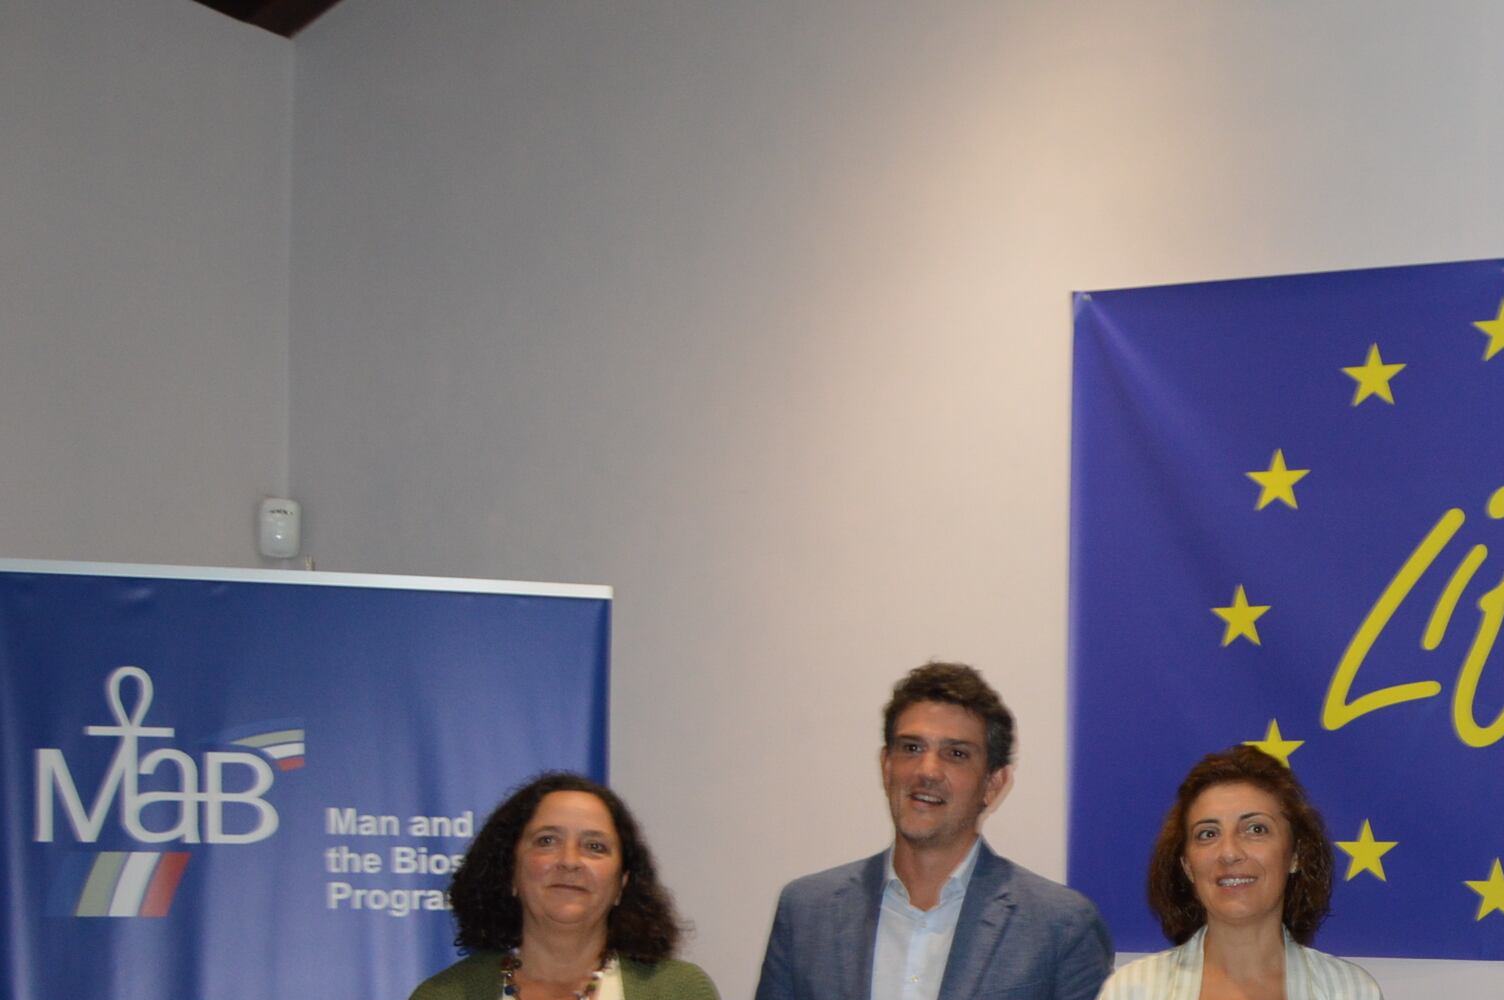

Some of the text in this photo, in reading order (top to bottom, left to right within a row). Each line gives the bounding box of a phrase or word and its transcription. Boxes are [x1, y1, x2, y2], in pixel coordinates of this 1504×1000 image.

[33, 728, 280, 844] MaB
[325, 807, 474, 838] Man and
[325, 846, 465, 875] the Bios
[326, 881, 455, 917] Progra
